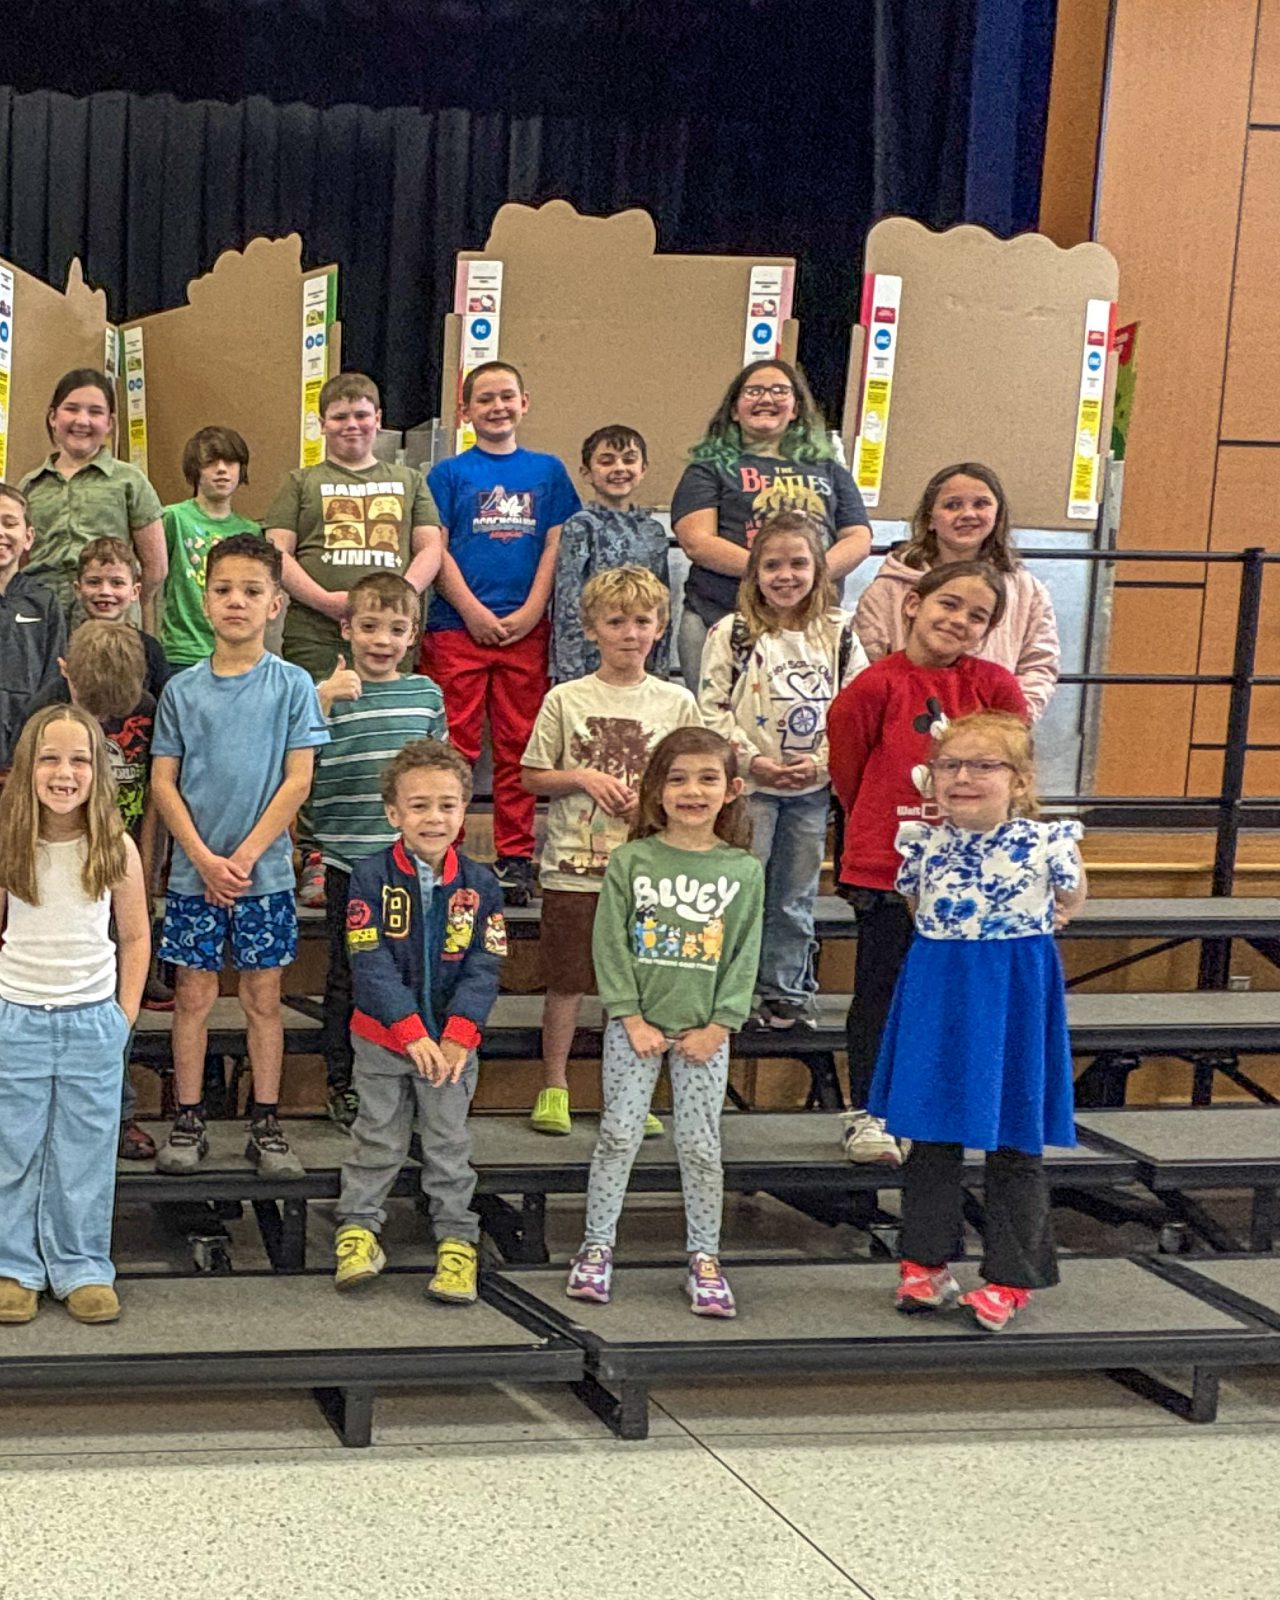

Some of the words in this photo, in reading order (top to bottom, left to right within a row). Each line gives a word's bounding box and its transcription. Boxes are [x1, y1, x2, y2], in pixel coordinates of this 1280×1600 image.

[740, 467, 832, 498] BEATLES
[332, 548, 396, 568] UNITE
[633, 874, 740, 922] BLUEY
